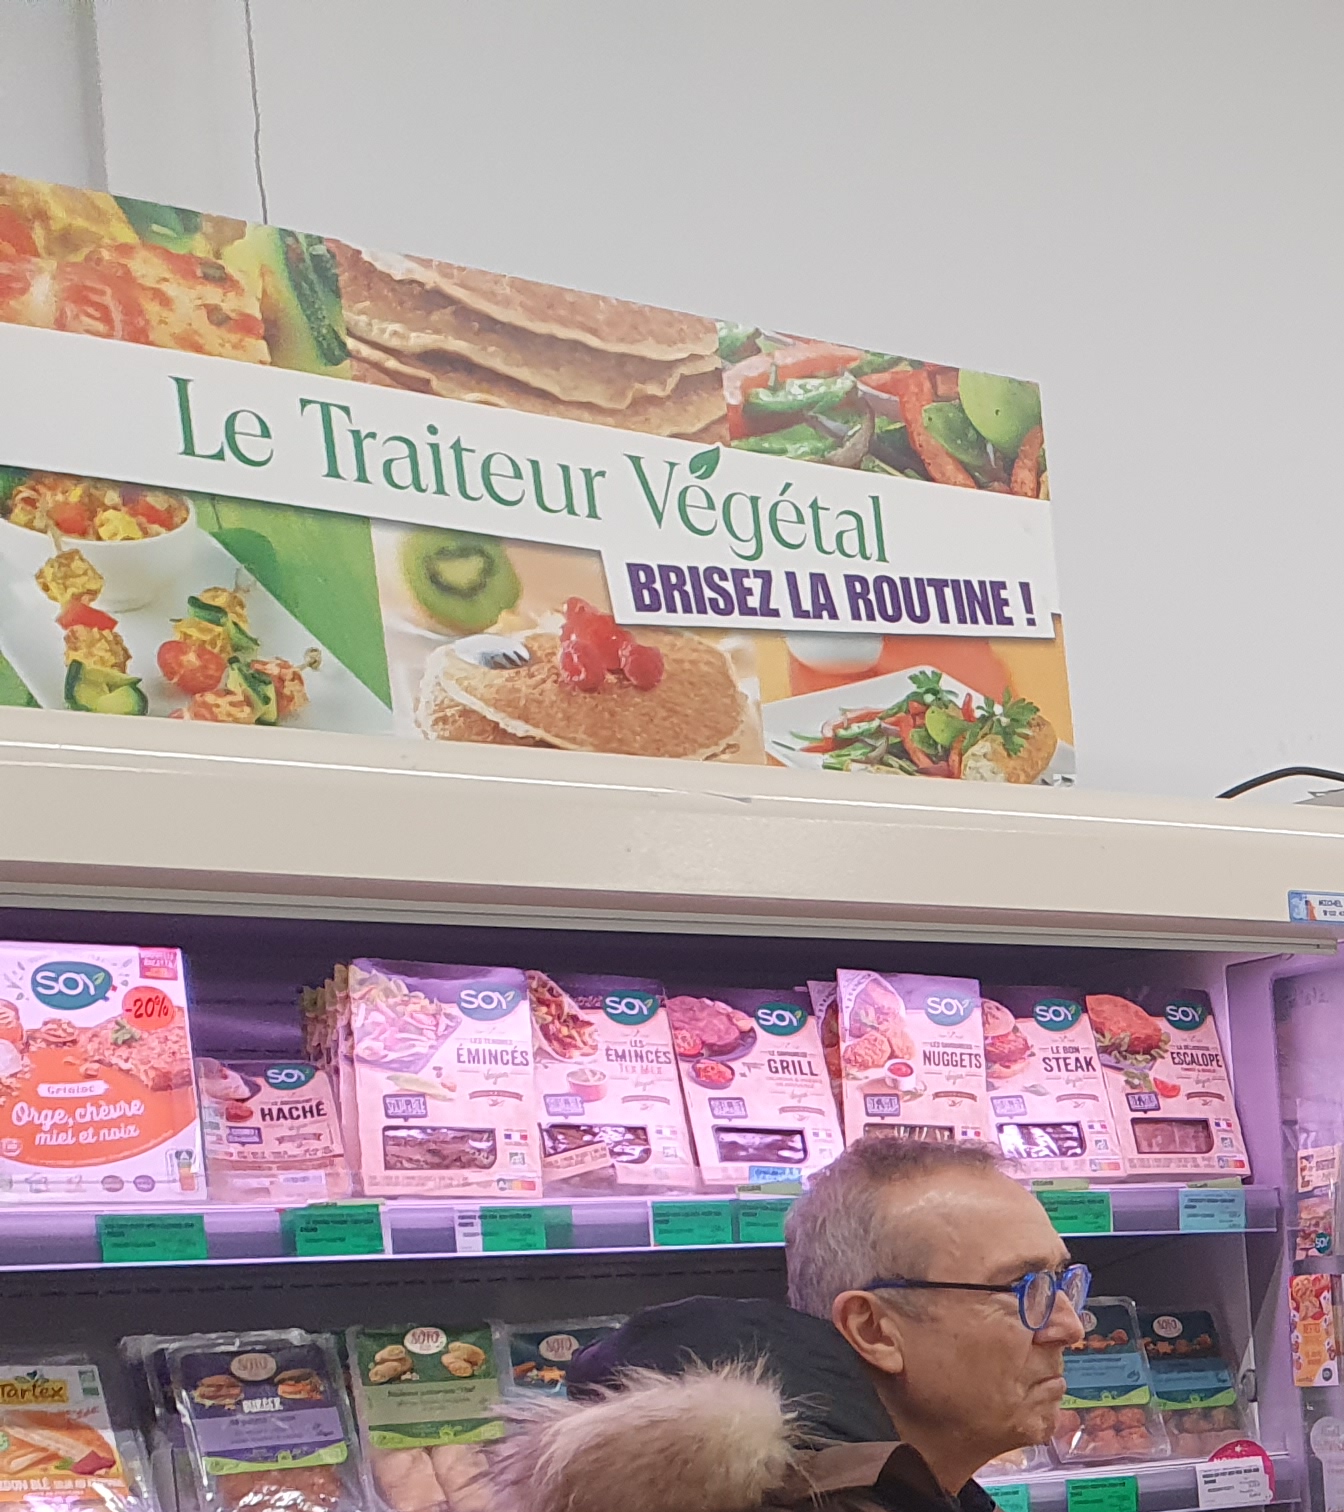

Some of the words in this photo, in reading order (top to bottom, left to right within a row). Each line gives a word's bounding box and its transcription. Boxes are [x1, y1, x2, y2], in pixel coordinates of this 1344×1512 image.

[169, 375, 274, 468] Le
[299, 397, 606, 521] Traiteur
[623, 446, 889, 564] Végétal
[626, 562, 781, 619] BRISEZ
[784, 570, 839, 621] LA
[844, 573, 1013, 627] ROUTINE
[1019, 581, 1037, 627] !
[35, 970, 104, 996] SOY
[124, 995, 169, 1019] -20%
[460, 989, 515, 1010] SOY
[605, 996, 652, 1016] SOY
[927, 996, 969, 1016] SOY
[757, 1009, 802, 1027] SOY
[1035, 1005, 1076, 1021] SOY
[1166, 1005, 1202, 1022] SOY
[457, 1044, 530, 1067] ÉMINCÉS
[923, 1050, 982, 1069] NUGGETS
[1042, 1056, 1097, 1073] STEAK
[1170, 1052, 1222, 1068] ESCALOPE
[768, 1058, 819, 1077] GRILL
[12, 1102, 73, 1131] Orge,
[75, 1099, 145, 1124] chèvre
[35, 1129, 76, 1146] miel
[79, 1127, 97, 1143] et
[99, 1124, 141, 1141] noix
[0, 1383, 64, 1399] Tartex
